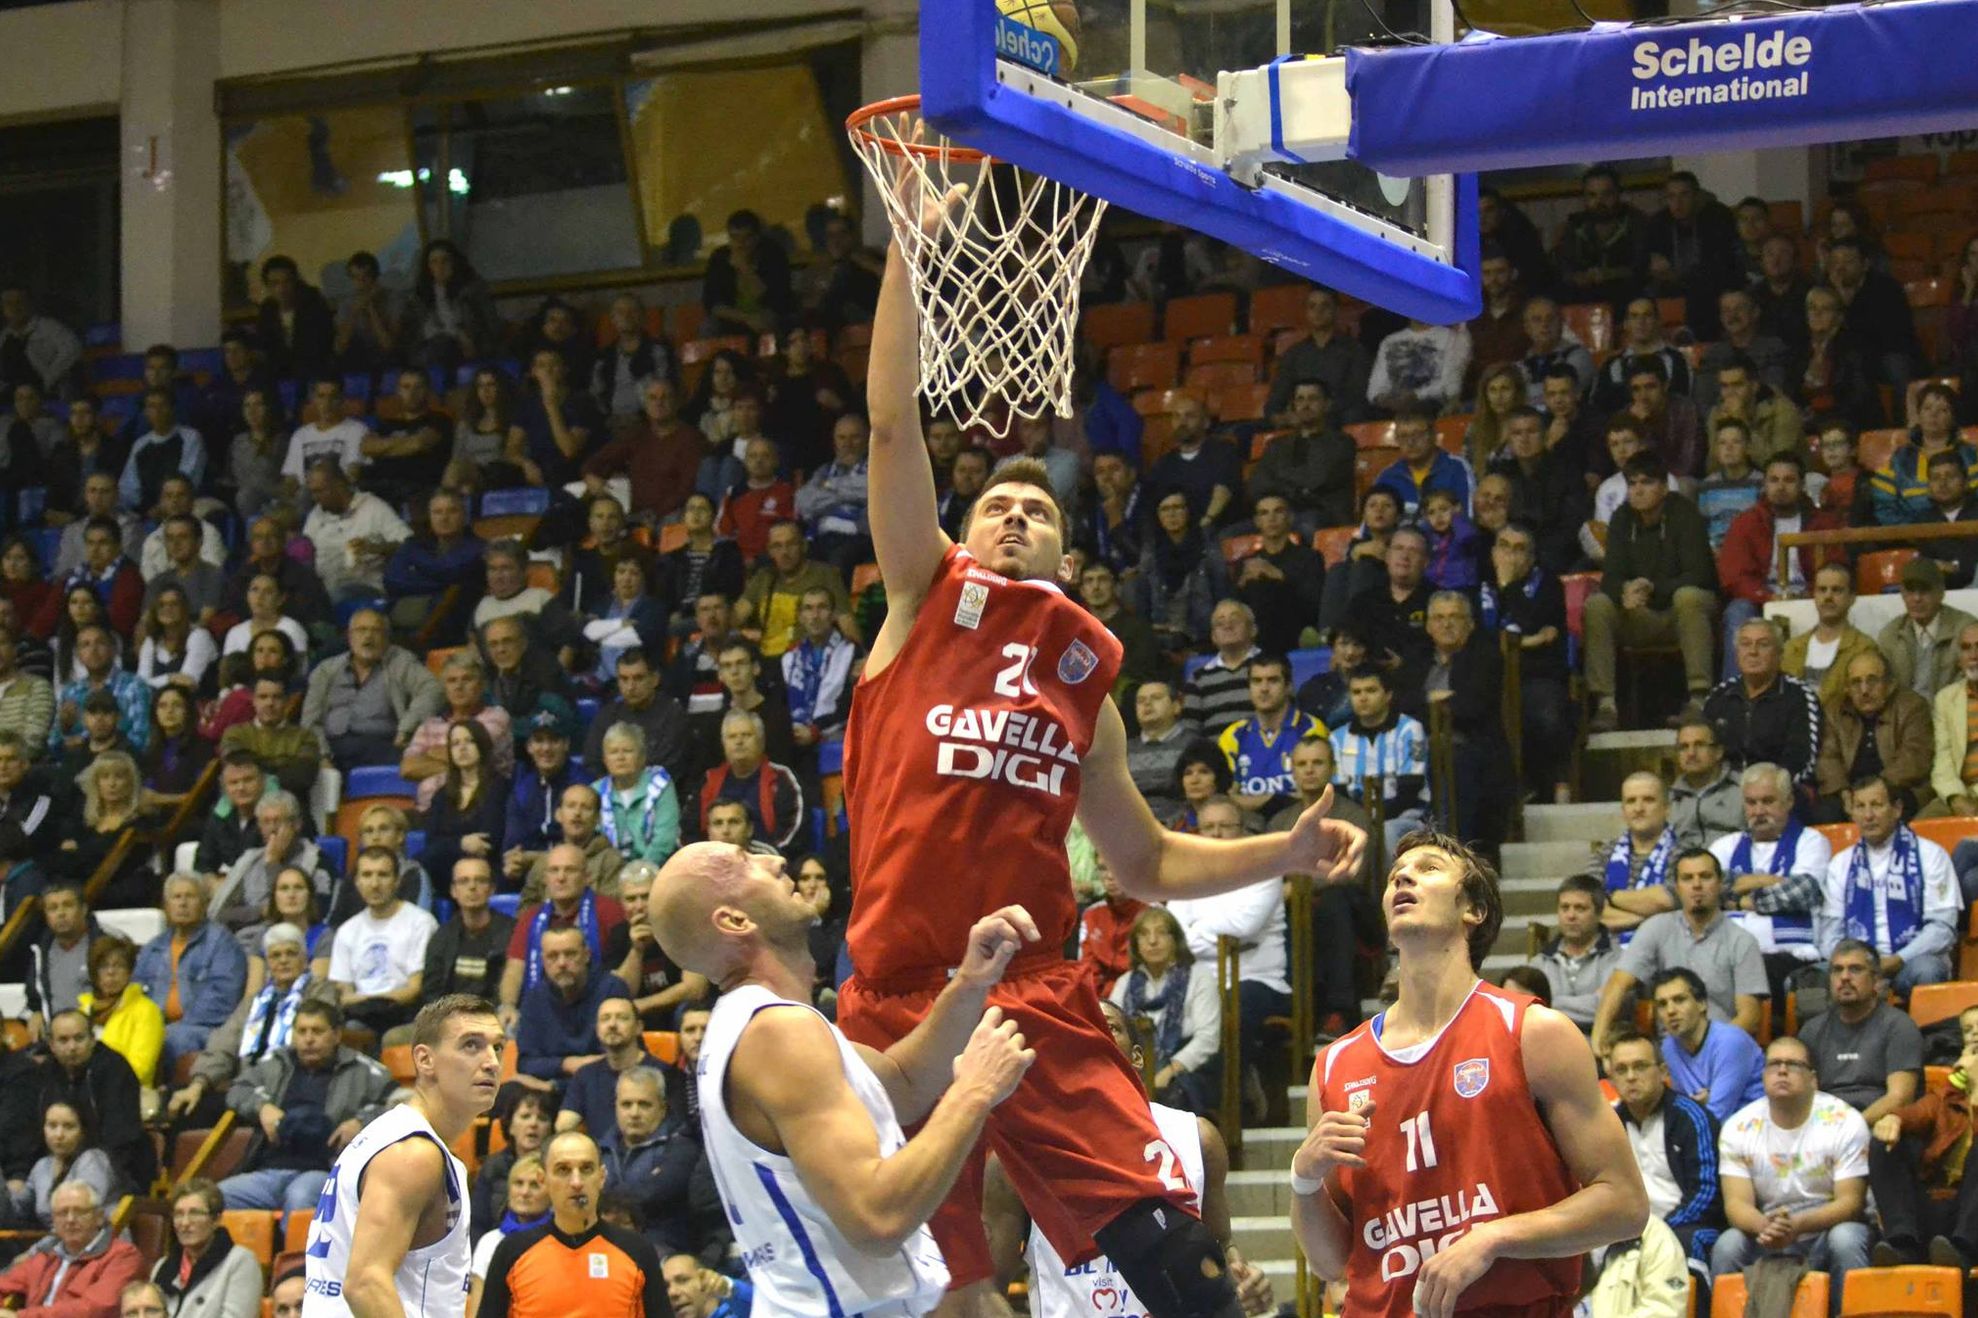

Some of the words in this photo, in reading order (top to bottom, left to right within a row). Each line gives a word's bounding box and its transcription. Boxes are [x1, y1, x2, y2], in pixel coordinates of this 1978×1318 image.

[1632, 30, 1812, 80] Schelde
[1631, 72, 1809, 110] International
[936, 741, 1066, 797] DIGI
[1400, 1110, 1438, 1173] 11
[1363, 1182, 1500, 1250] GAVELLA
